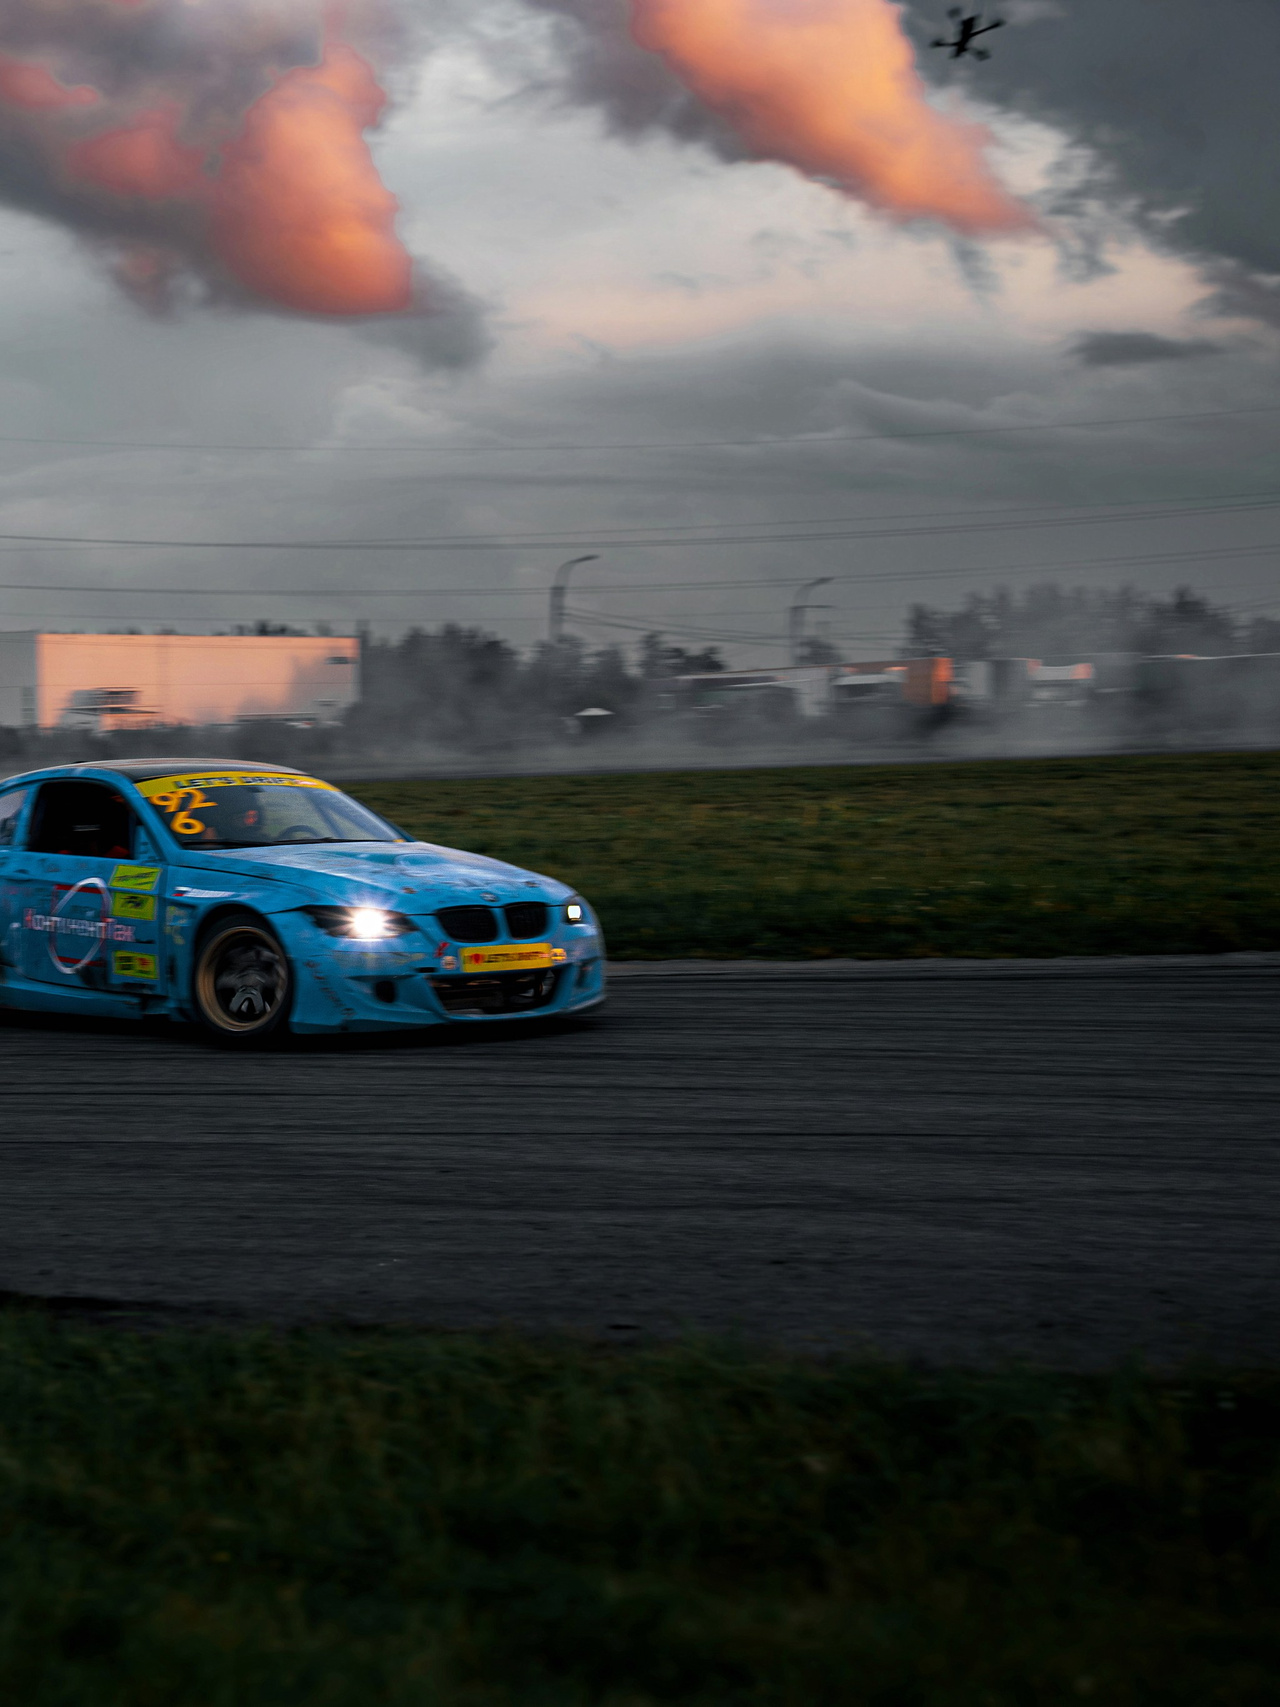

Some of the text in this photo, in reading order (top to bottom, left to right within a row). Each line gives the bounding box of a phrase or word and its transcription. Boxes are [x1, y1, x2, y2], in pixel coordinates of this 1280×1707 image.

[175, 777, 235, 789] LET'S
[148, 788, 218, 813] 92
[170, 811, 206, 835] 6
